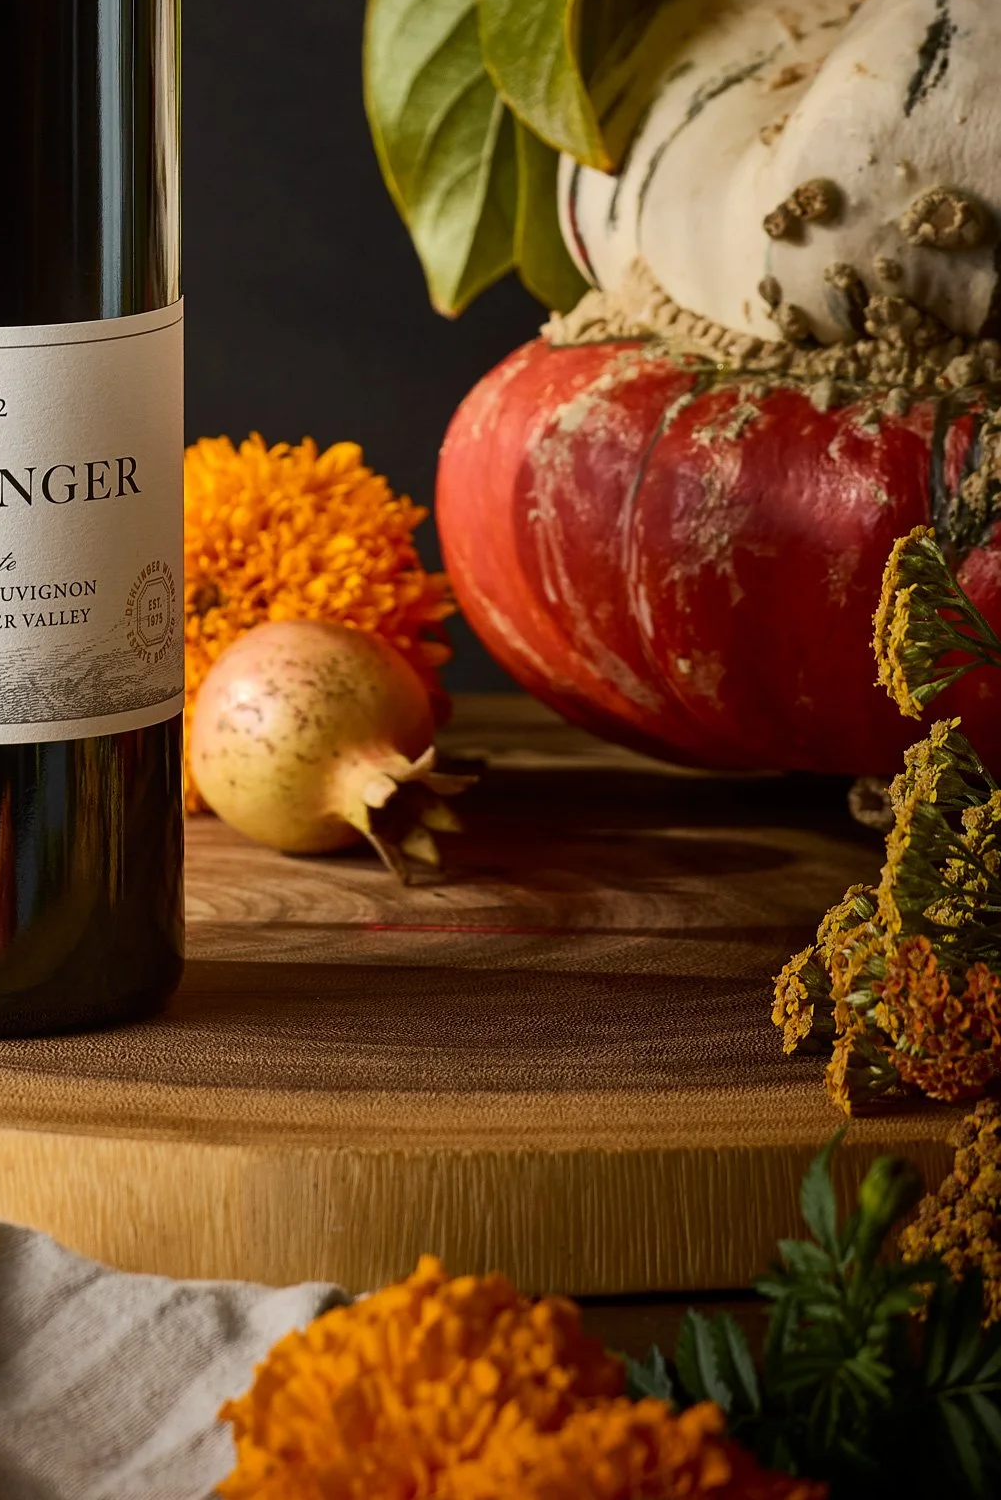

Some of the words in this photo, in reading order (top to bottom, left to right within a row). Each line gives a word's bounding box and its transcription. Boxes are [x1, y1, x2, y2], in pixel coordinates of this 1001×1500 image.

[125, 560, 160, 616] DEHLINGER
[148, 596, 163, 612] EST.
[22, 607, 92, 628] VALLEY
[147, 612, 163, 628] 1975
[126, 630, 151, 664] ESTATE
